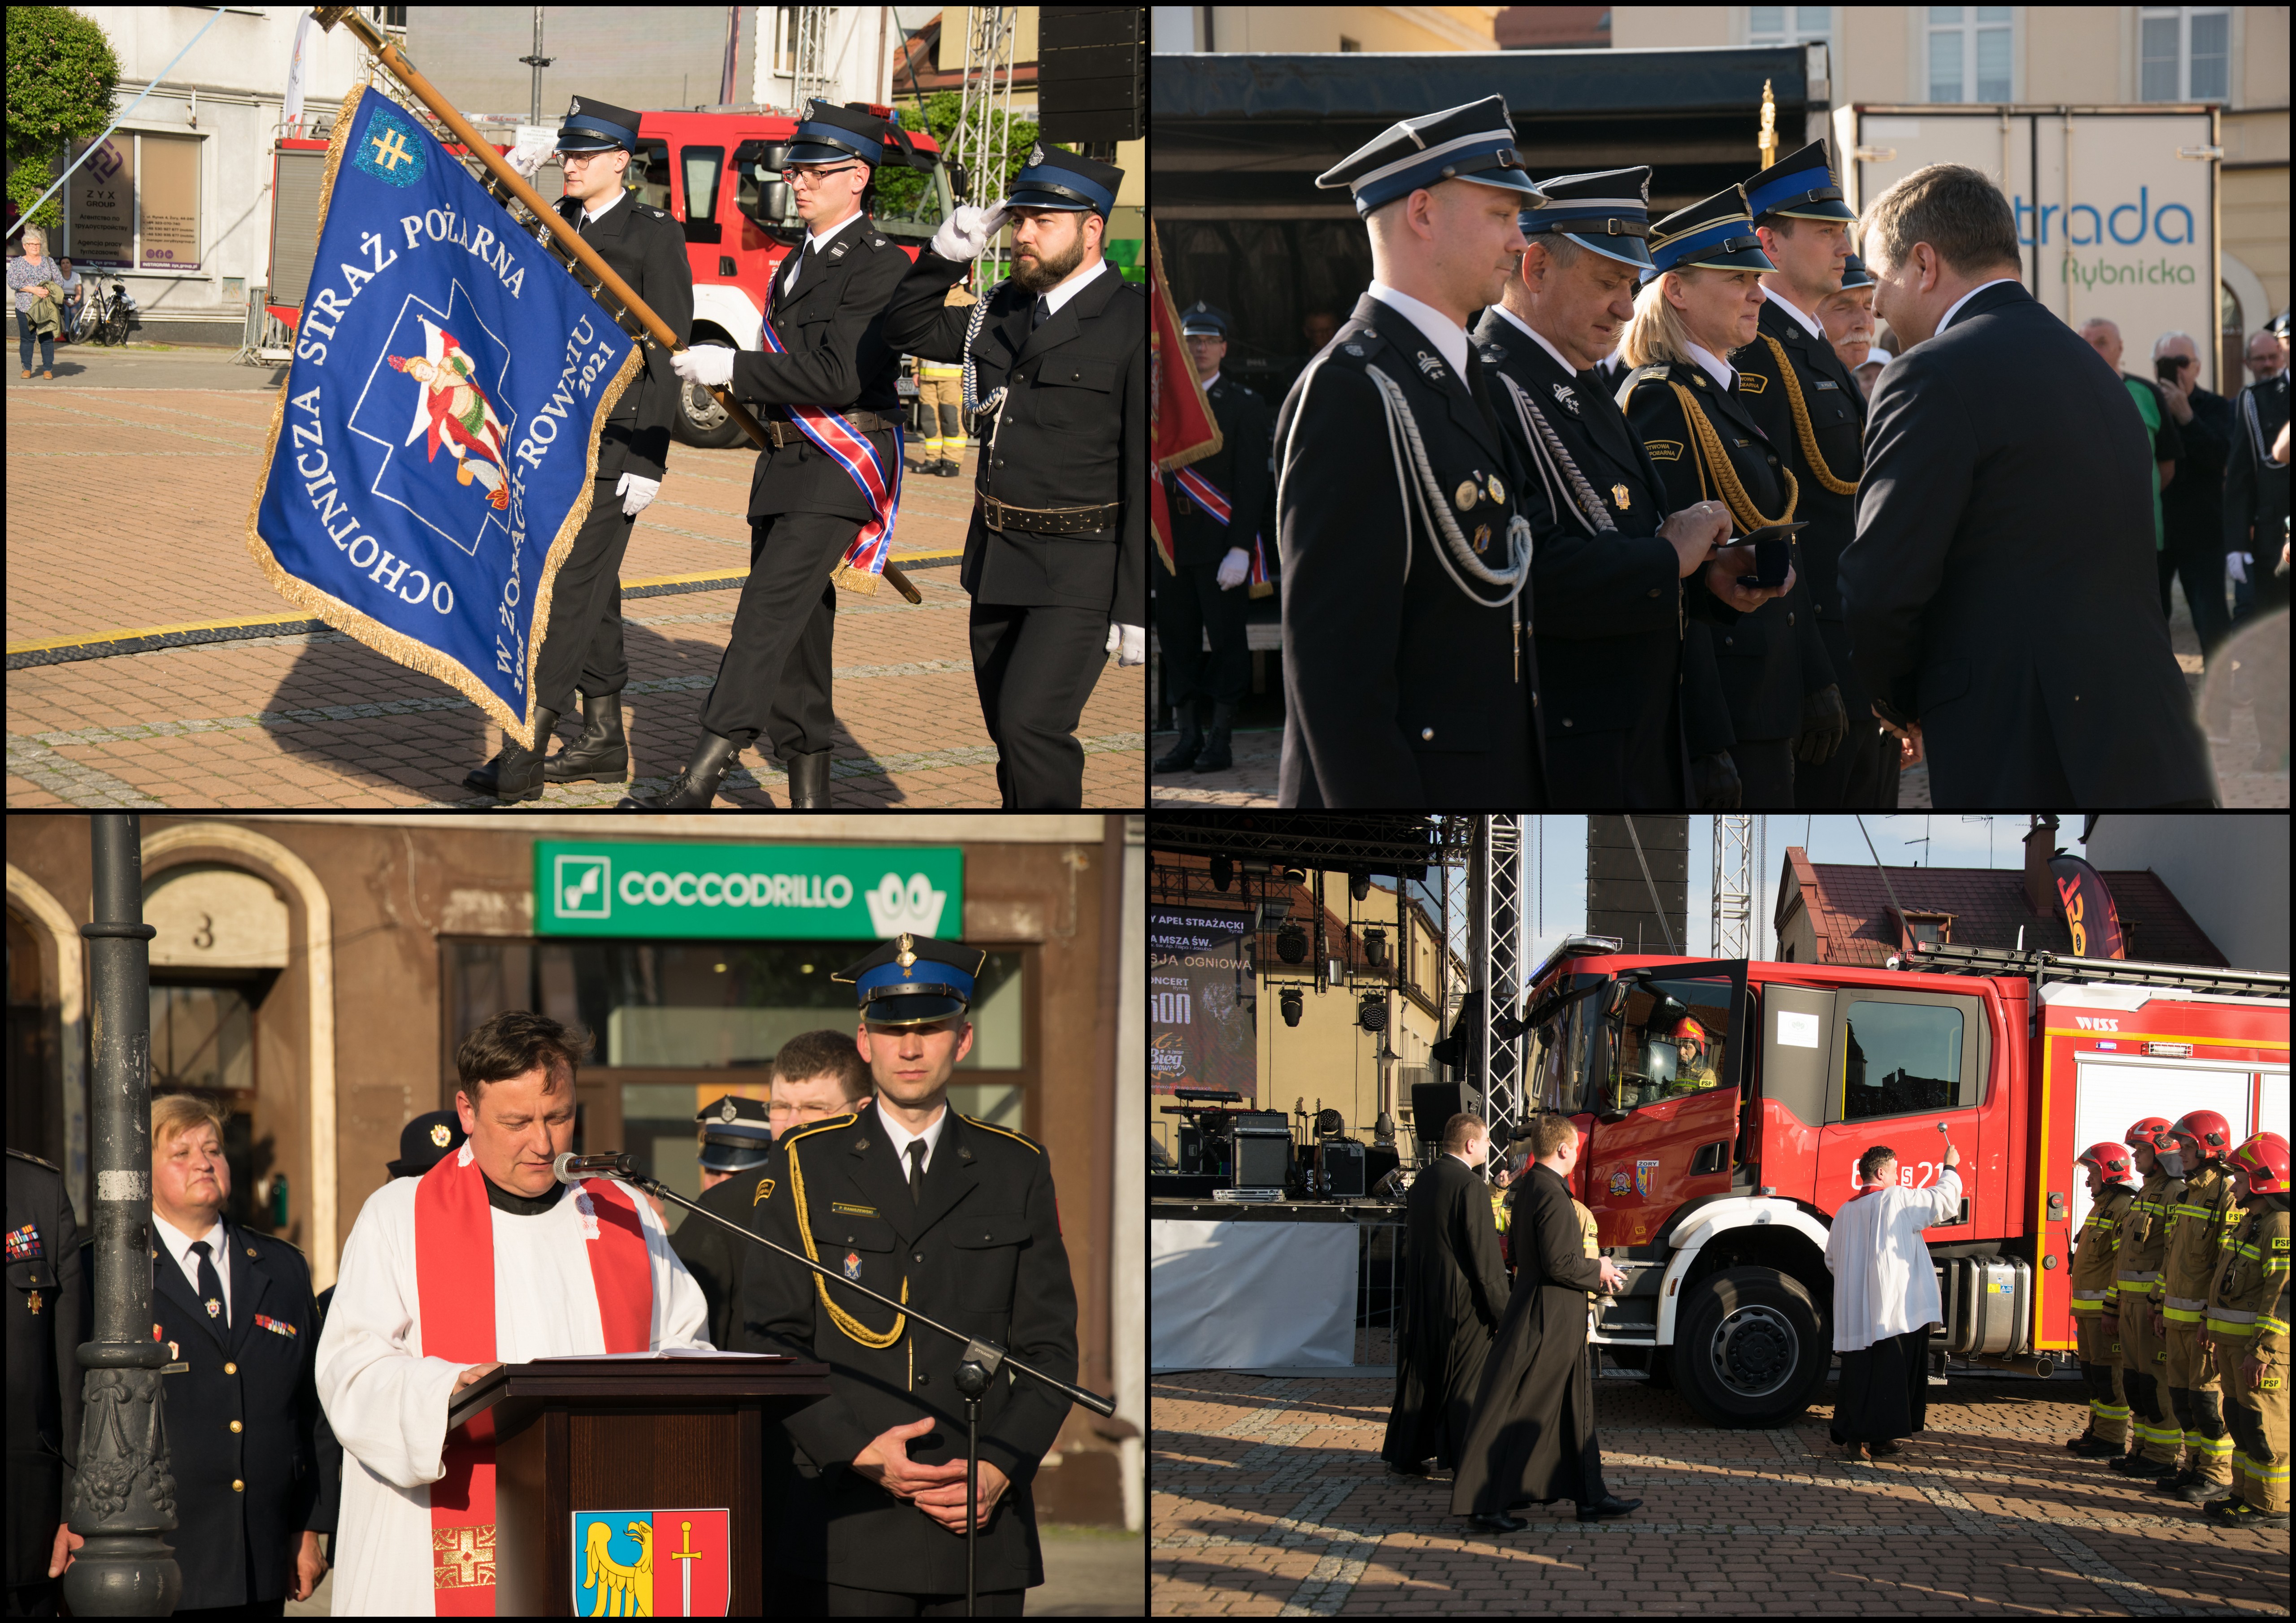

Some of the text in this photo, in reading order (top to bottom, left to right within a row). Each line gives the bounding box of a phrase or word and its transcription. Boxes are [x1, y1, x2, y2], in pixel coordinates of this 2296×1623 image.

[75, 223, 128, 231] трудоустройству
[2013, 185, 2195, 246] trada
[2061, 257, 2195, 291] Rybnicka
[578, 341, 617, 398] 2021
[291, 203, 524, 614] OCHOTNICZA STRAŻ POŻARNA
[497, 634, 512, 674] W
[618, 871, 853, 909] COCCODRILLO
[192, 912, 215, 950] 3
[1159, 916, 1184, 925] APEL
[1186, 918, 1244, 930] STRAŻACKI
[1160, 935, 1190, 946] MSZA
[1191, 936, 1212, 946] ŚW.
[1185, 956, 1252, 970] OGNIOWA
[2075, 1016, 2119, 1032] WISS
